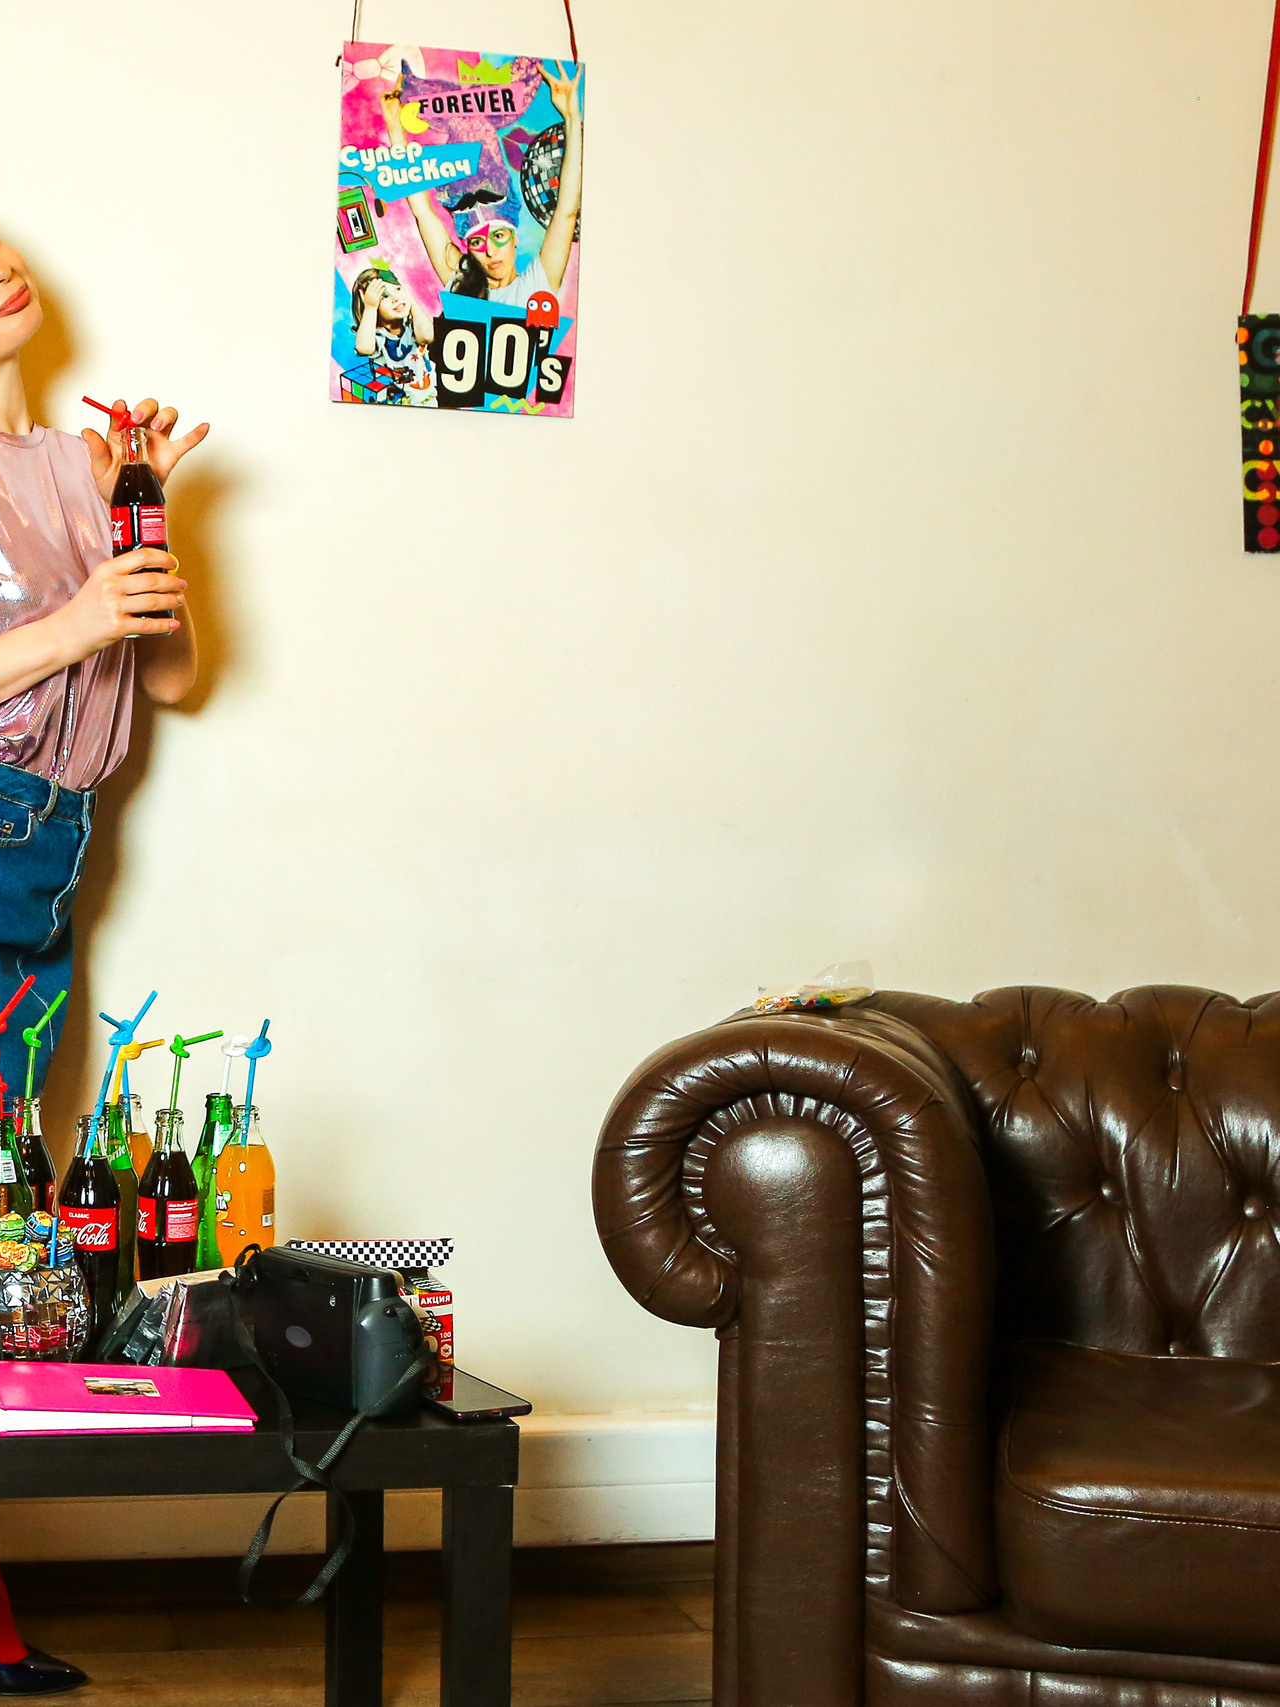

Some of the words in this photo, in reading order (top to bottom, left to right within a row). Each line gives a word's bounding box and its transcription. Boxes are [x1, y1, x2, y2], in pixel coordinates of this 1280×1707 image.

[419, 88, 516, 114] FOREVER
[340, 141, 423, 172] Супер
[420, 1294, 451, 1305] АКЦИЯ
[440, 1331, 452, 1339] 100
